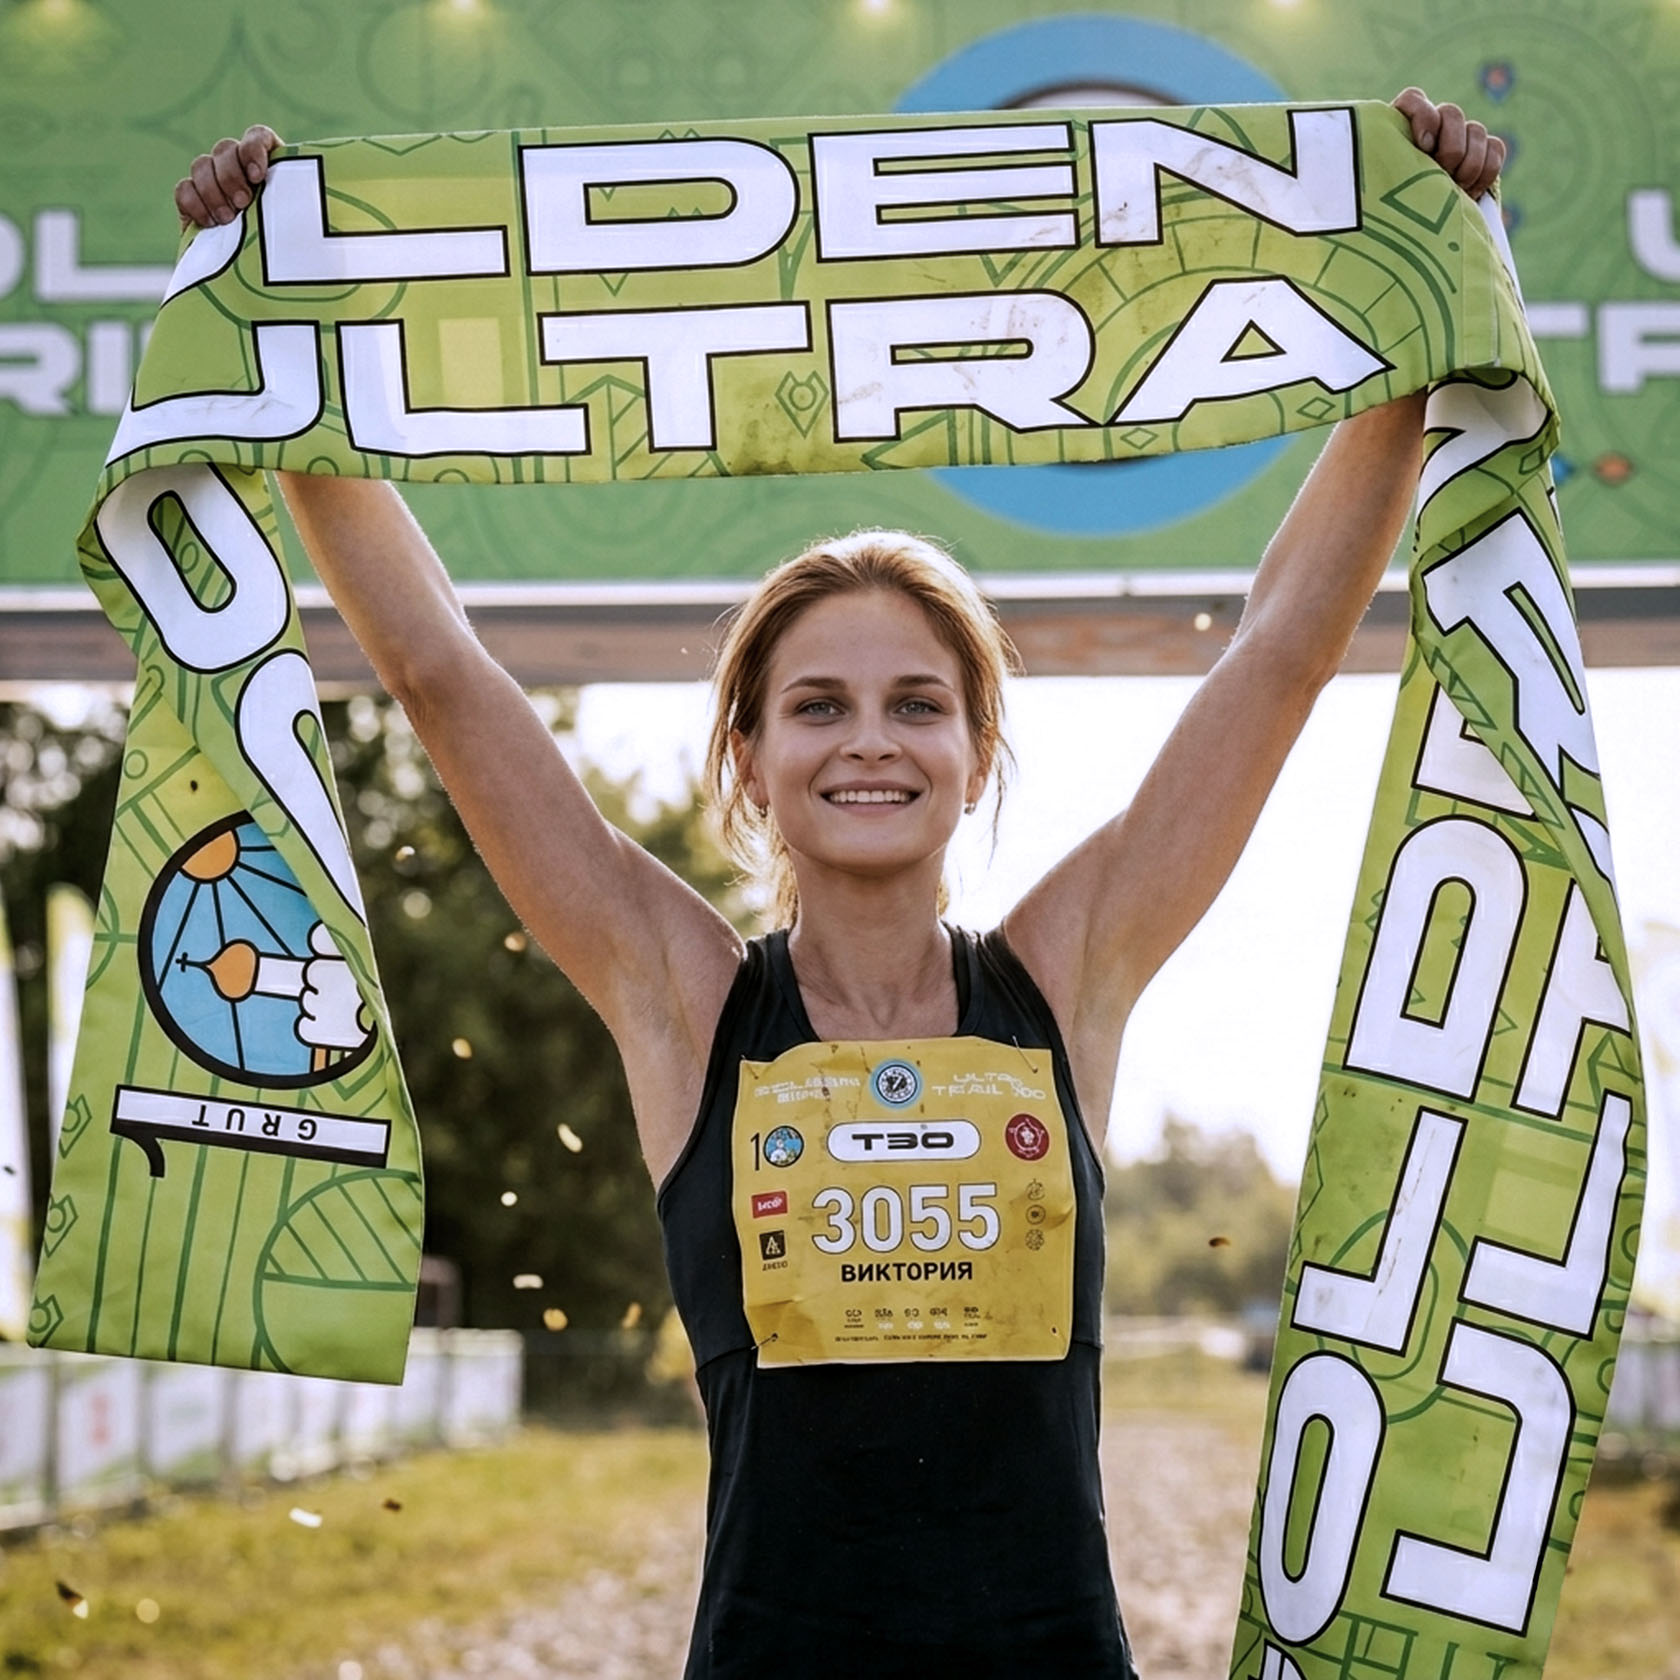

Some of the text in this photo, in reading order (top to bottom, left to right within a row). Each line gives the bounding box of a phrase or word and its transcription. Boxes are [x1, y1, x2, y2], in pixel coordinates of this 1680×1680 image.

[192, 1105, 317, 1140] GRUT
[811, 1182, 1001, 1254] 3055
[840, 1262, 973, 1282] ВИКТОРИЯ
